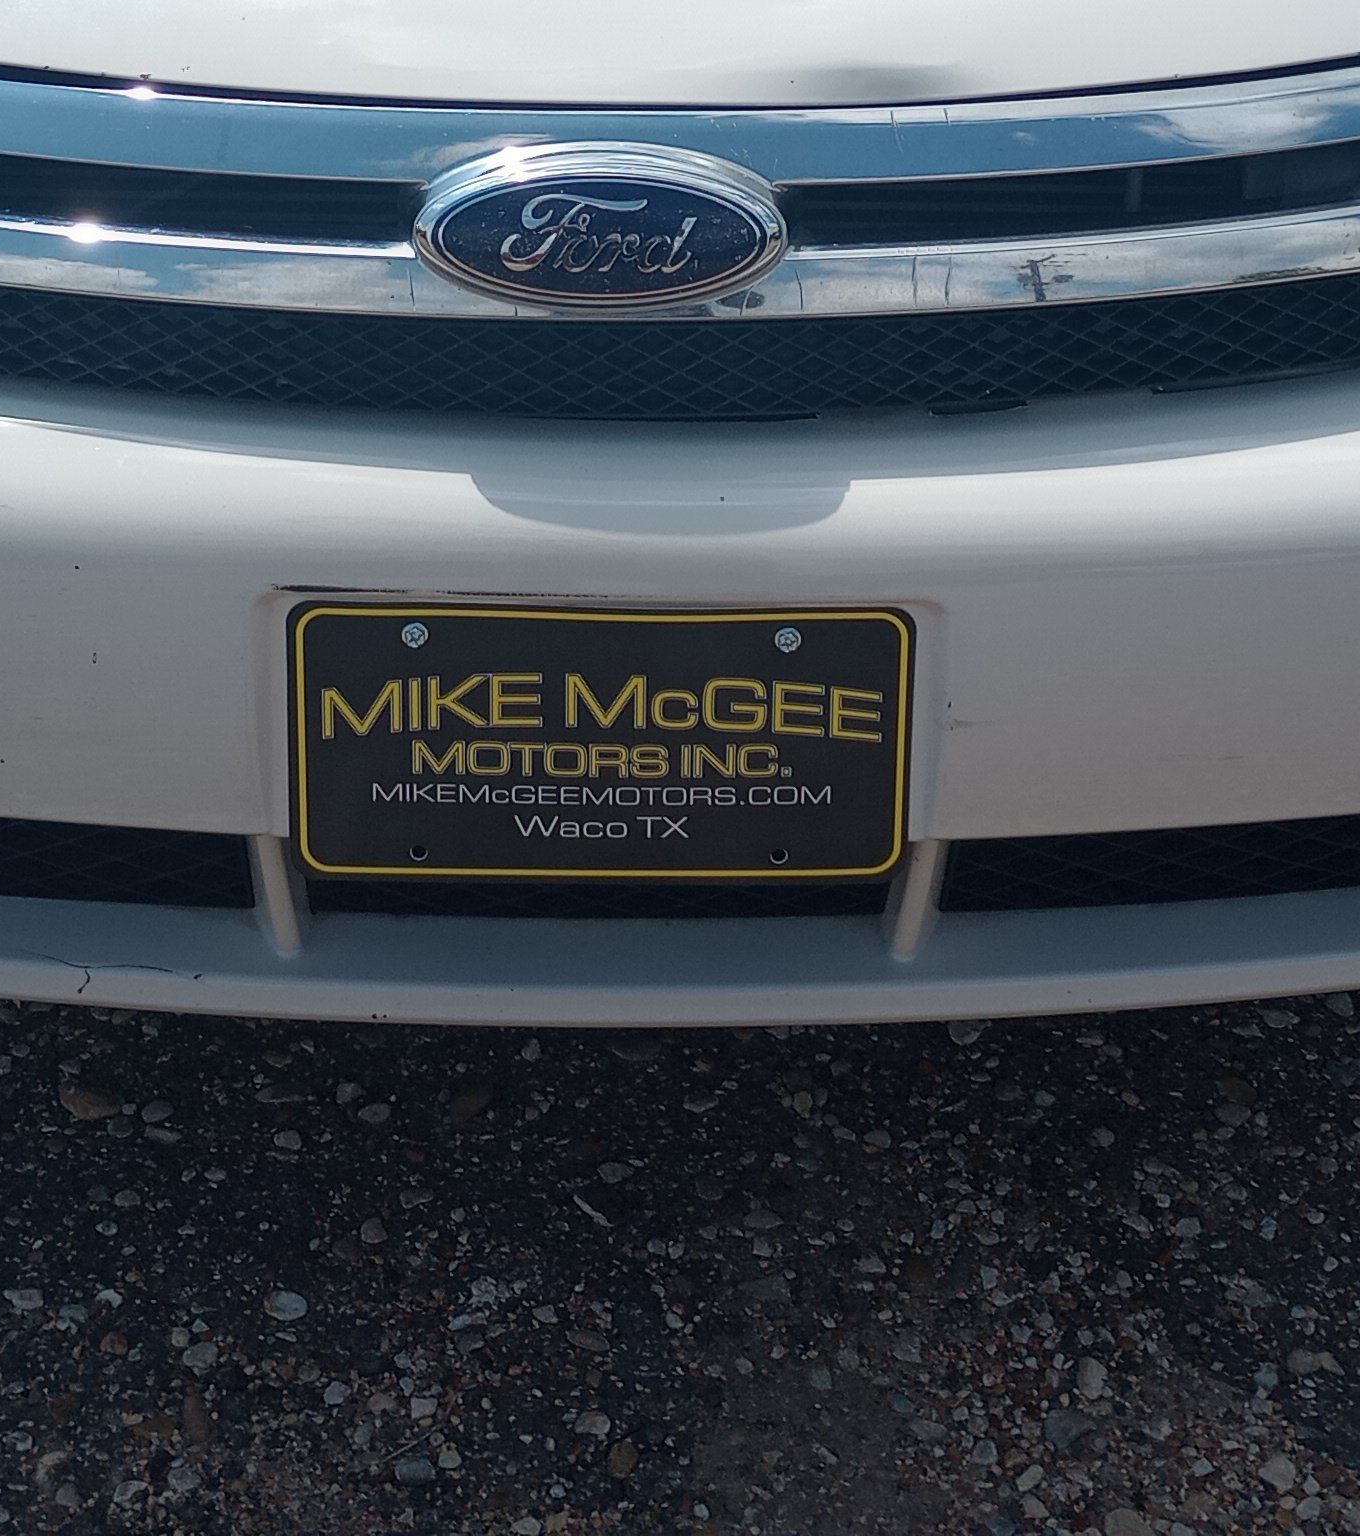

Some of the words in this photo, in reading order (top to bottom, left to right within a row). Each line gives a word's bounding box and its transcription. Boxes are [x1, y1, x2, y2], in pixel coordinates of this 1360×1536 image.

[500, 194, 697, 273] Ford
[321, 672, 543, 740] MIKE
[565, 672, 883, 743] McGEE
[411, 739, 669, 778] MOTORS
[680, 743, 793, 778] INC.
[371, 782, 832, 806] MIKEMcGEEMOTORS.COM
[514, 814, 628, 838] Waco
[636, 816, 690, 839] TX
